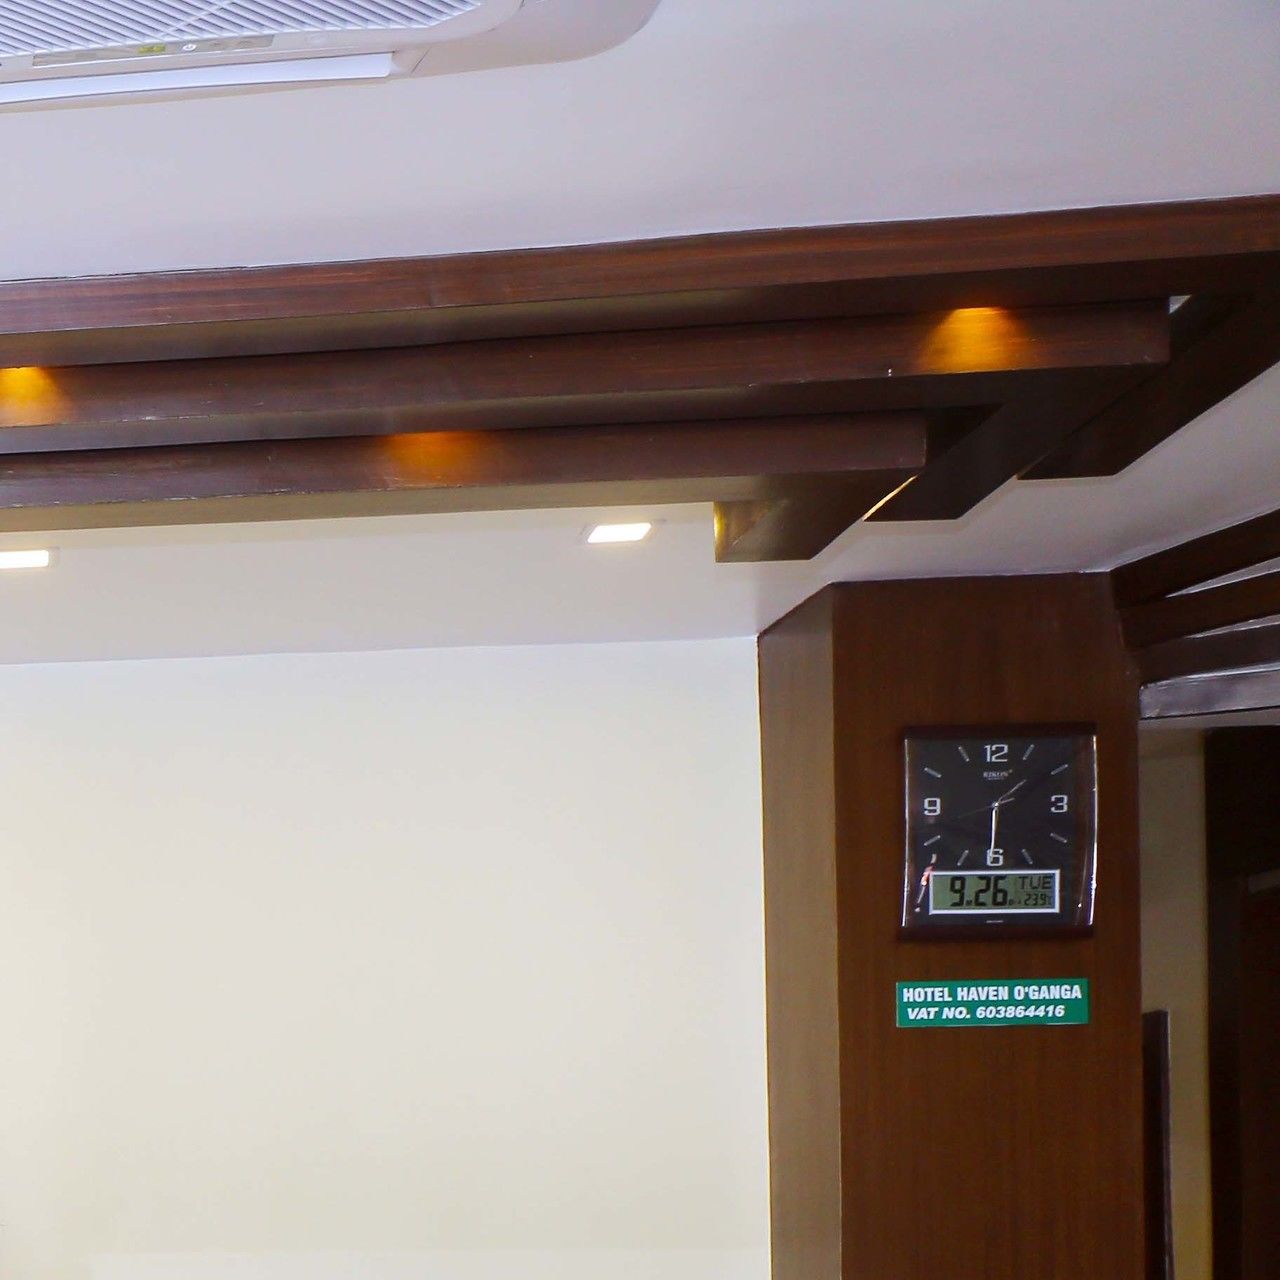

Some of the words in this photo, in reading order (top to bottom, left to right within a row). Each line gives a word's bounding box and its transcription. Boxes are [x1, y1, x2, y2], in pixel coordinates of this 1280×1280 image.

[983, 743, 1009, 762] 12
[923, 797, 941, 816] 9
[1050, 794, 1068, 813] 3
[986, 848, 1004, 867] 6
[1018, 875, 1053, 890] TUE
[902, 987, 953, 1003] HOTEL
[956, 985, 1009, 1002] HAVEN
[1013, 984, 1082, 1001] O'GANGA
[907, 1007, 939, 1020] VAT
[942, 1006, 971, 1019] NO.
[975, 1005, 1065, 1019] 603864416
